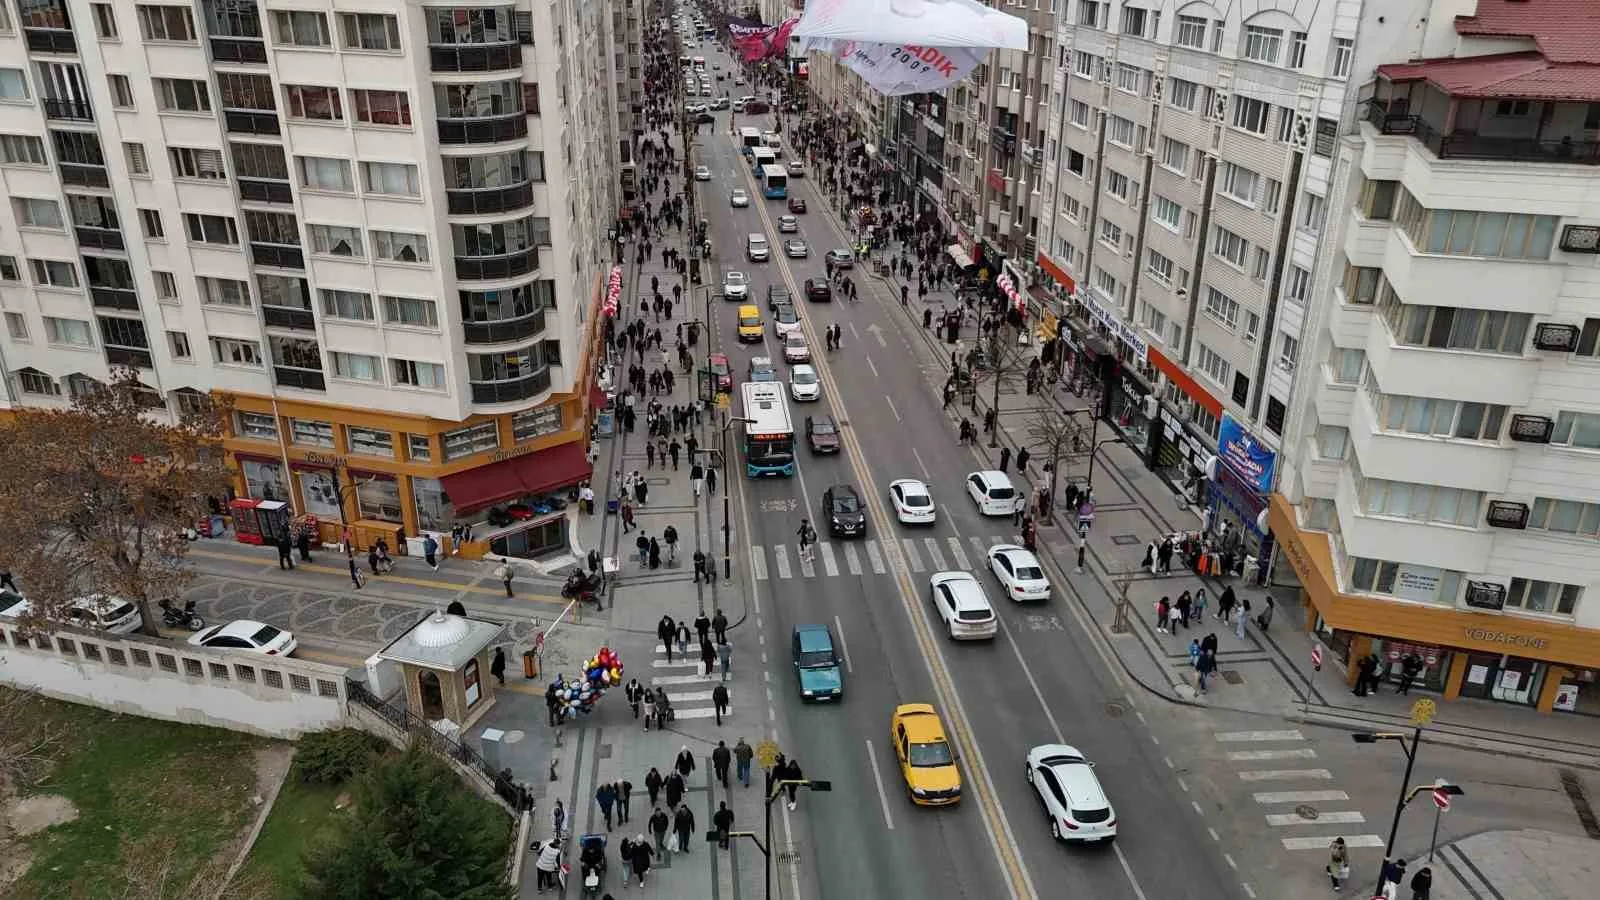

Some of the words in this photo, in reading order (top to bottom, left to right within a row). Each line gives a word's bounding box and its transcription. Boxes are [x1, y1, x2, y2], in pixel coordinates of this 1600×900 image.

[891, 47, 930, 74] 2009
[1120, 324, 1145, 355] Merkezi
[1464, 628, 1546, 650] VODAFONE
